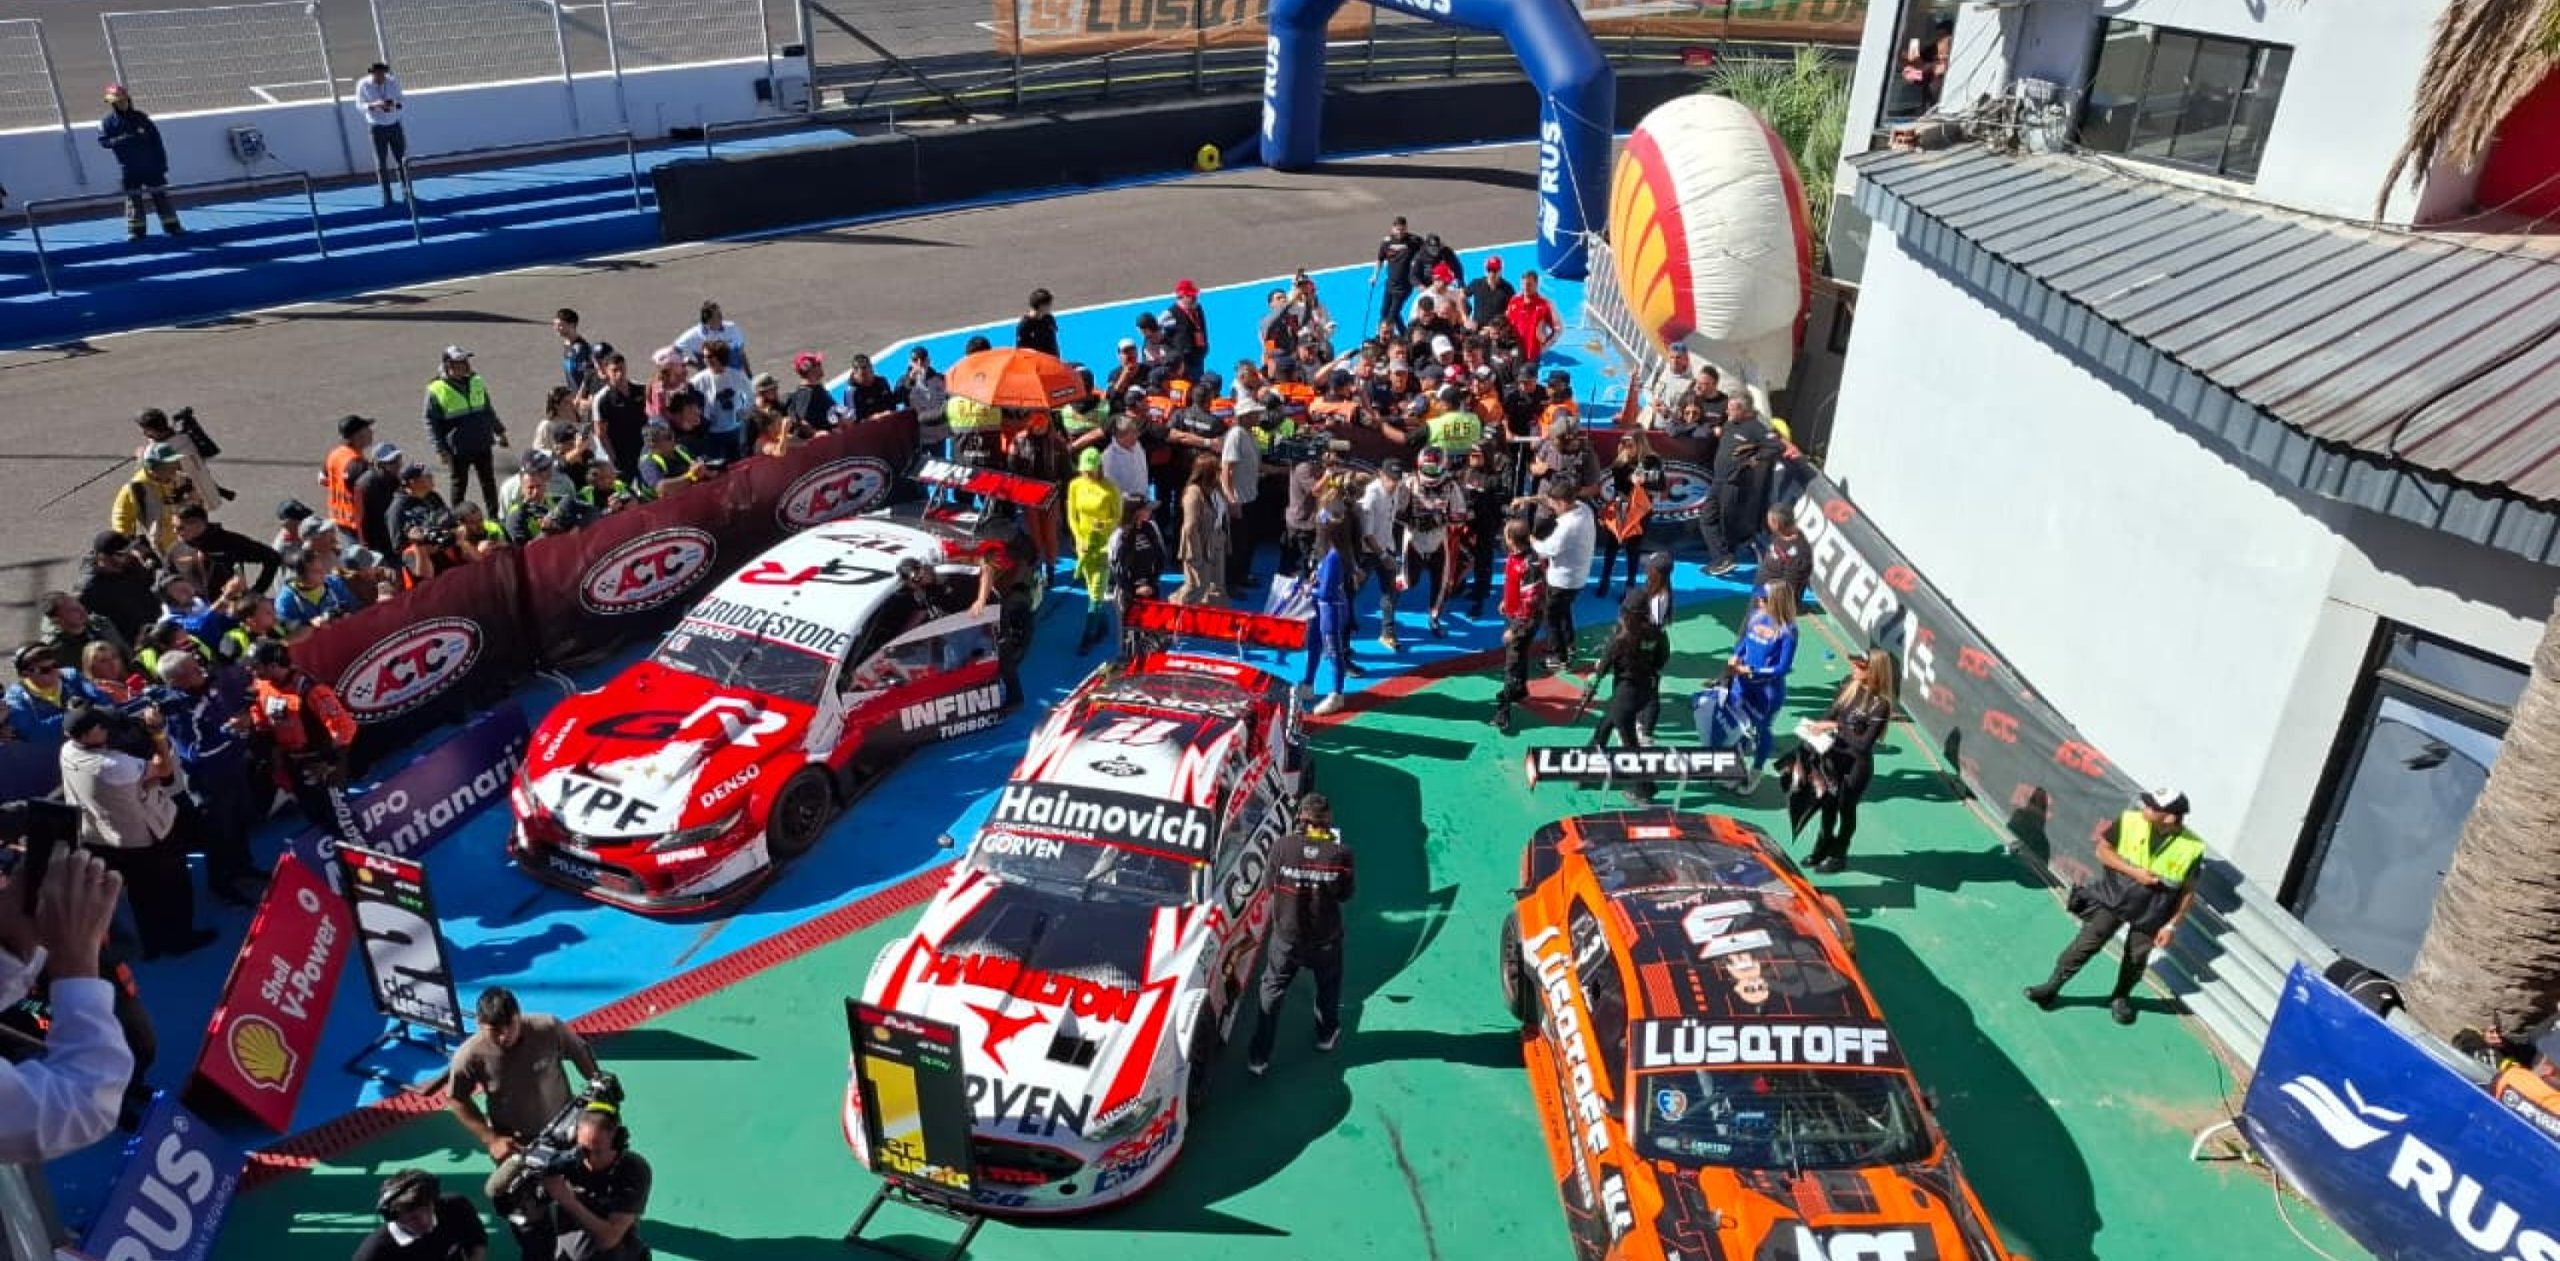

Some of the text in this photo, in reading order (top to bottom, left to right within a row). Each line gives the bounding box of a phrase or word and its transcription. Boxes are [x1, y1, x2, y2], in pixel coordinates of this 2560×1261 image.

[1265, 35, 1280, 98] RUS
[1541, 121, 1561, 194] RUS
[615, 545, 685, 597] ACTC
[683, 621, 738, 642] DENSO
[694, 597, 851, 653] BRIDGESTONE
[373, 638, 448, 701] ACTC
[585, 696, 786, 748] GR
[940, 714, 1002, 739] TURBOC
[700, 763, 761, 808] DENSO
[1539, 749, 1736, 774] LÜSQTOFF
[554, 777, 658, 831] YPF
[995, 784, 1207, 849] Haimovich
[981, 831, 1065, 859] GORVEN
[261, 954, 292, 1006] Shell
[280, 914, 337, 1020] V-Power
[916, 950, 1142, 1025] HAMILTON
[1643, 1018, 1889, 1067] LÜSQTOFF
[964, 1074, 1094, 1137] RVEN
